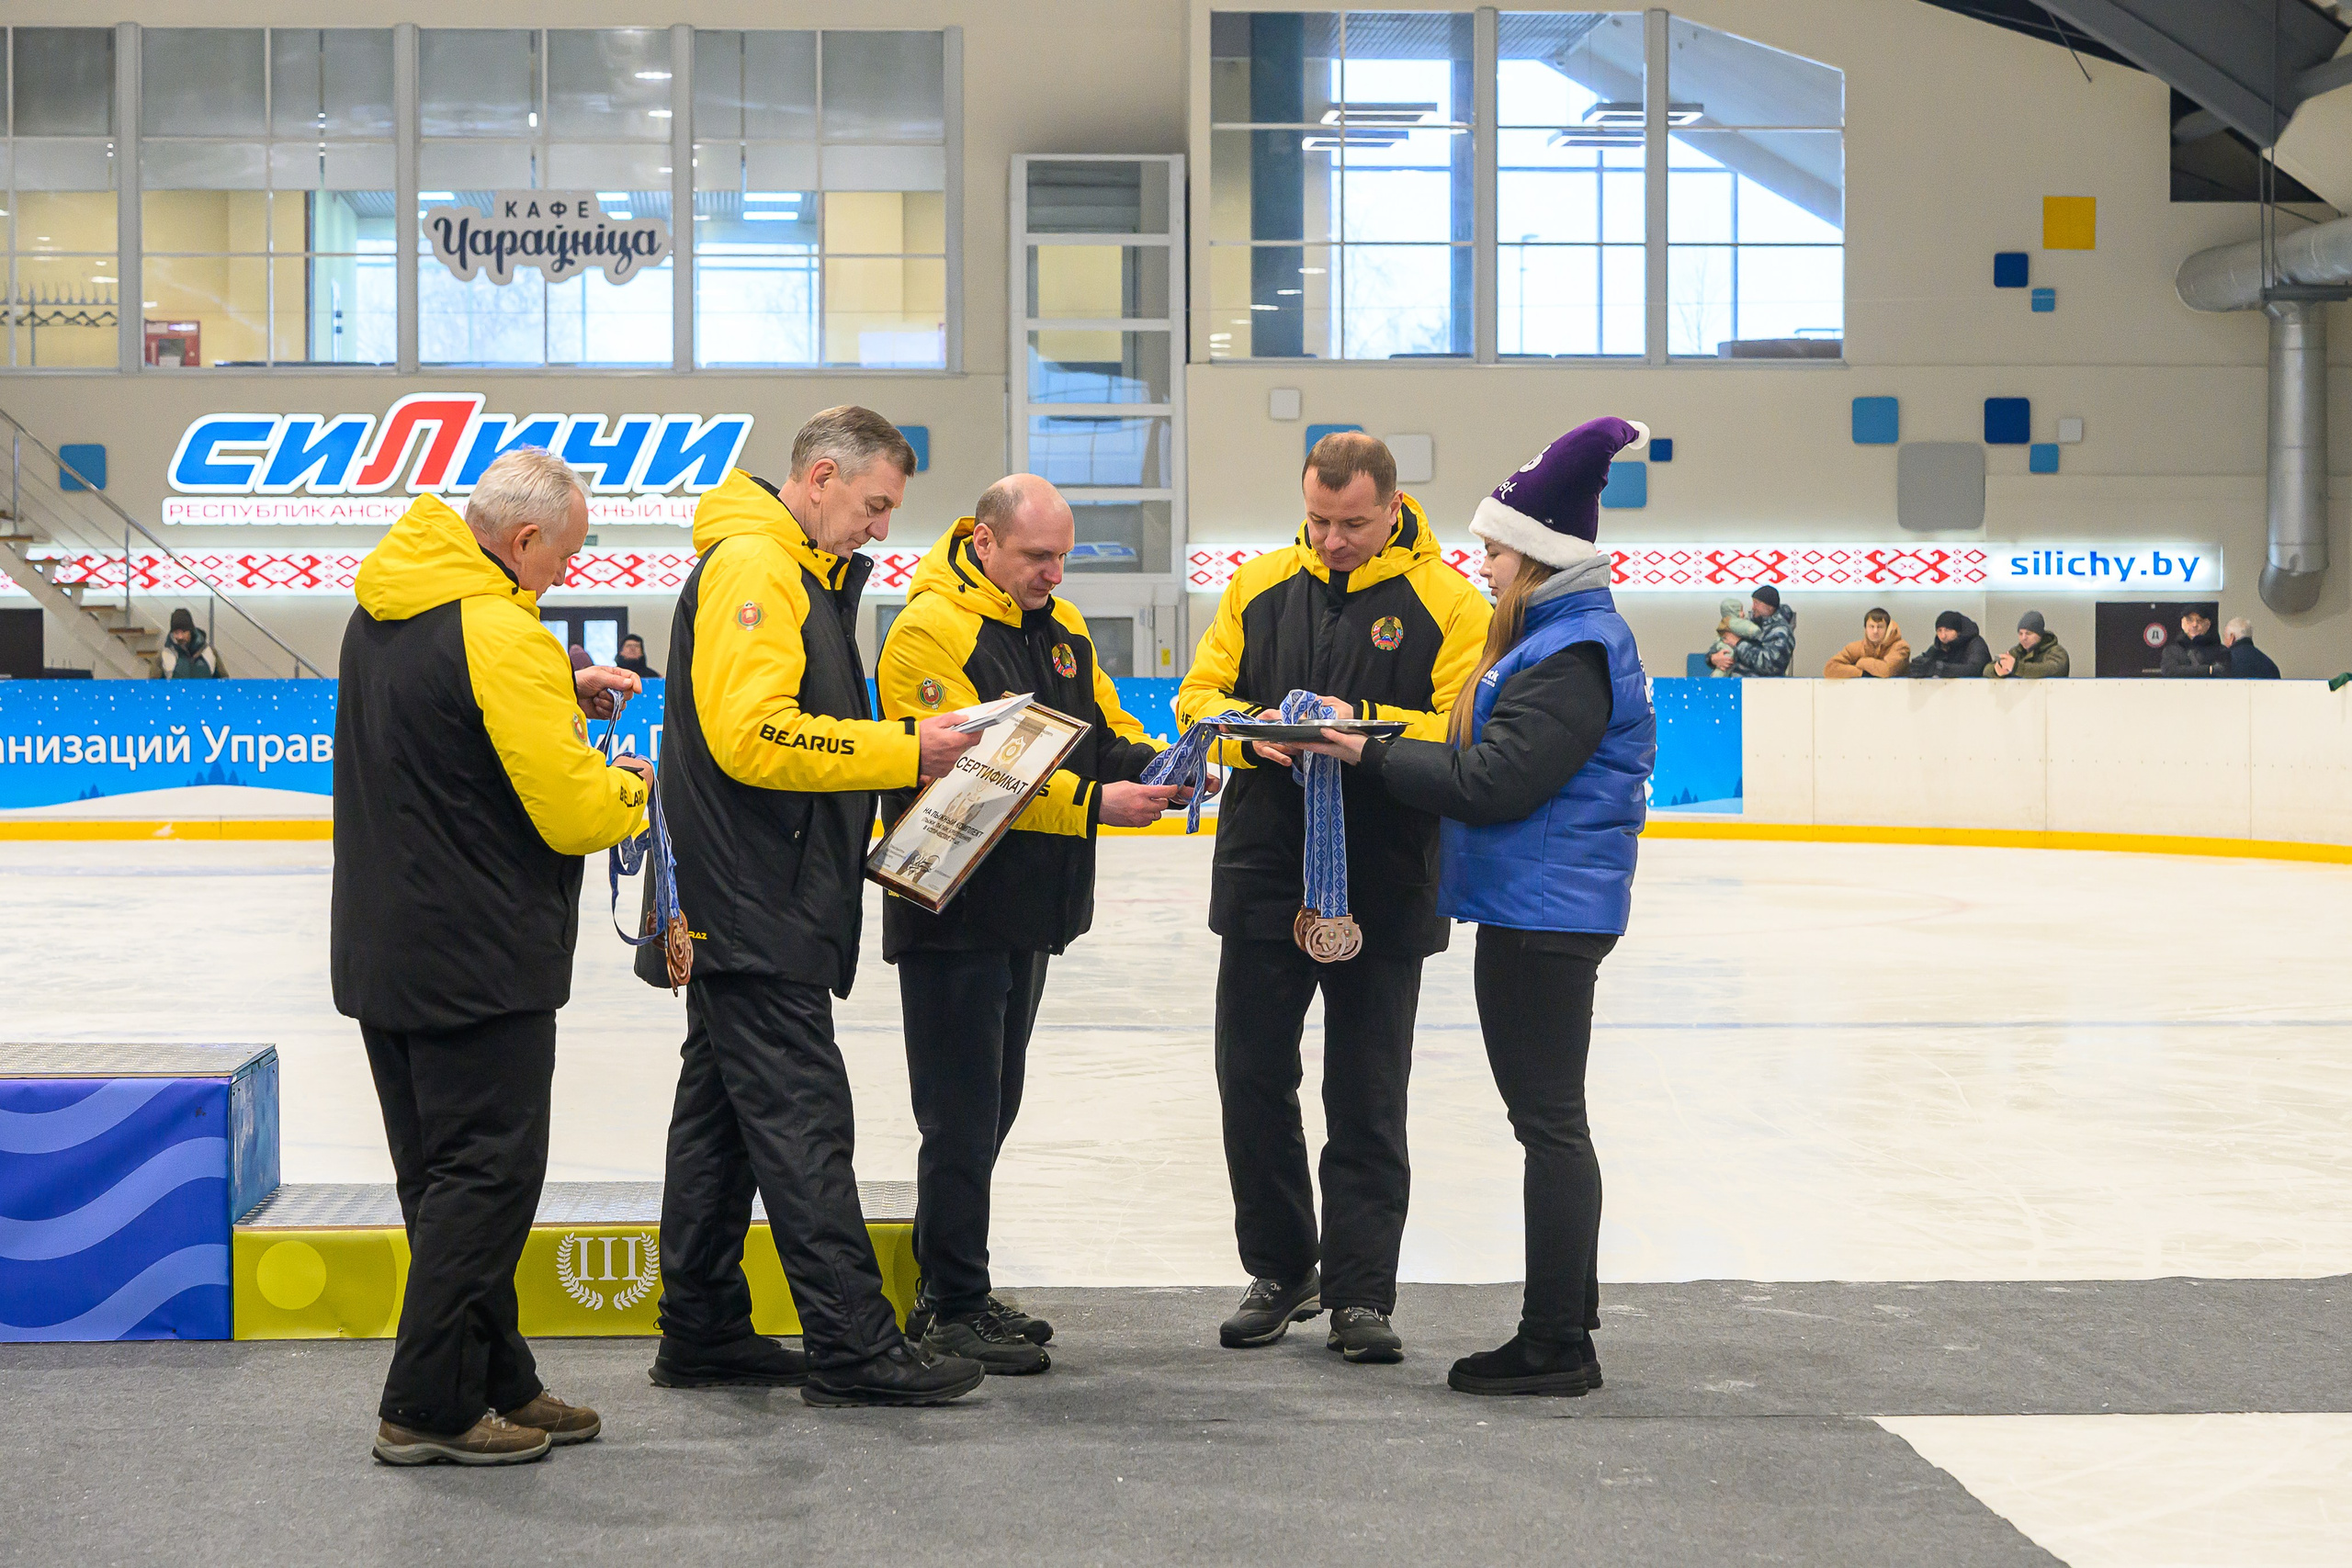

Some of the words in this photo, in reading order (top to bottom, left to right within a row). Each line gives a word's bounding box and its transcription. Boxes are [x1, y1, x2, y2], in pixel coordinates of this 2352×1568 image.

[505, 201, 590, 219] КАФЕ
[434, 217, 662, 276] Чараўніца
[169, 504, 406, 518] РЕСПУБЛИКАНСК
[2010, 550, 2200, 582] silichy.by
[956, 756, 1029, 795] СЕРТИФИКАТ
[573, 1236, 642, 1280] III
